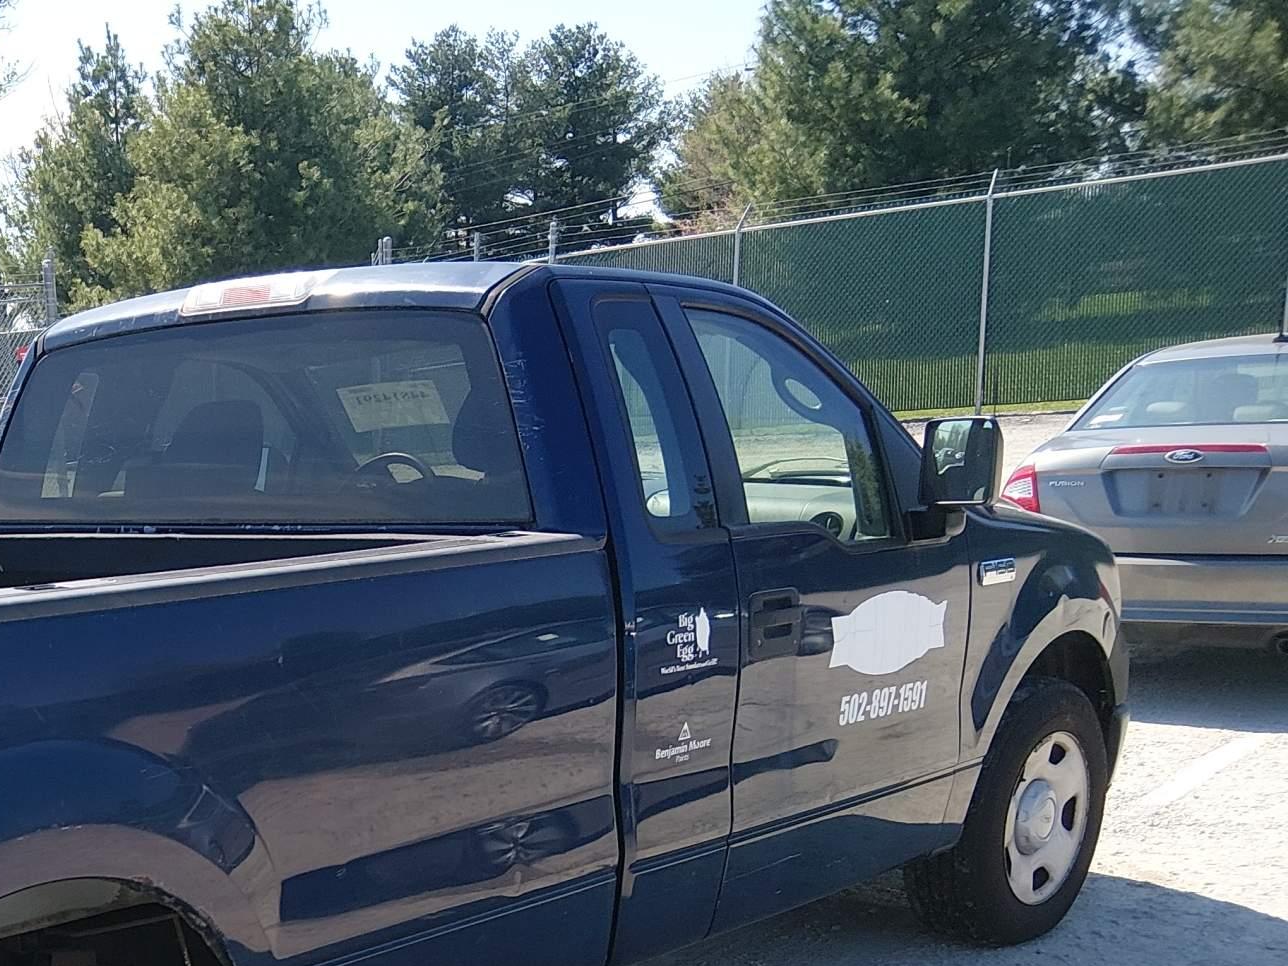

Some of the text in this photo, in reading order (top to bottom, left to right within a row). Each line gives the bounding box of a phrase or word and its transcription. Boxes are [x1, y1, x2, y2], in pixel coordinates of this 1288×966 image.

[678, 613, 694, 631] Big
[666, 630, 695, 645] Green
[677, 643, 695, 662] Egg
[839, 680, 928, 726] 502-897-1591
[655, 738, 712, 760] Benjamin Moore
